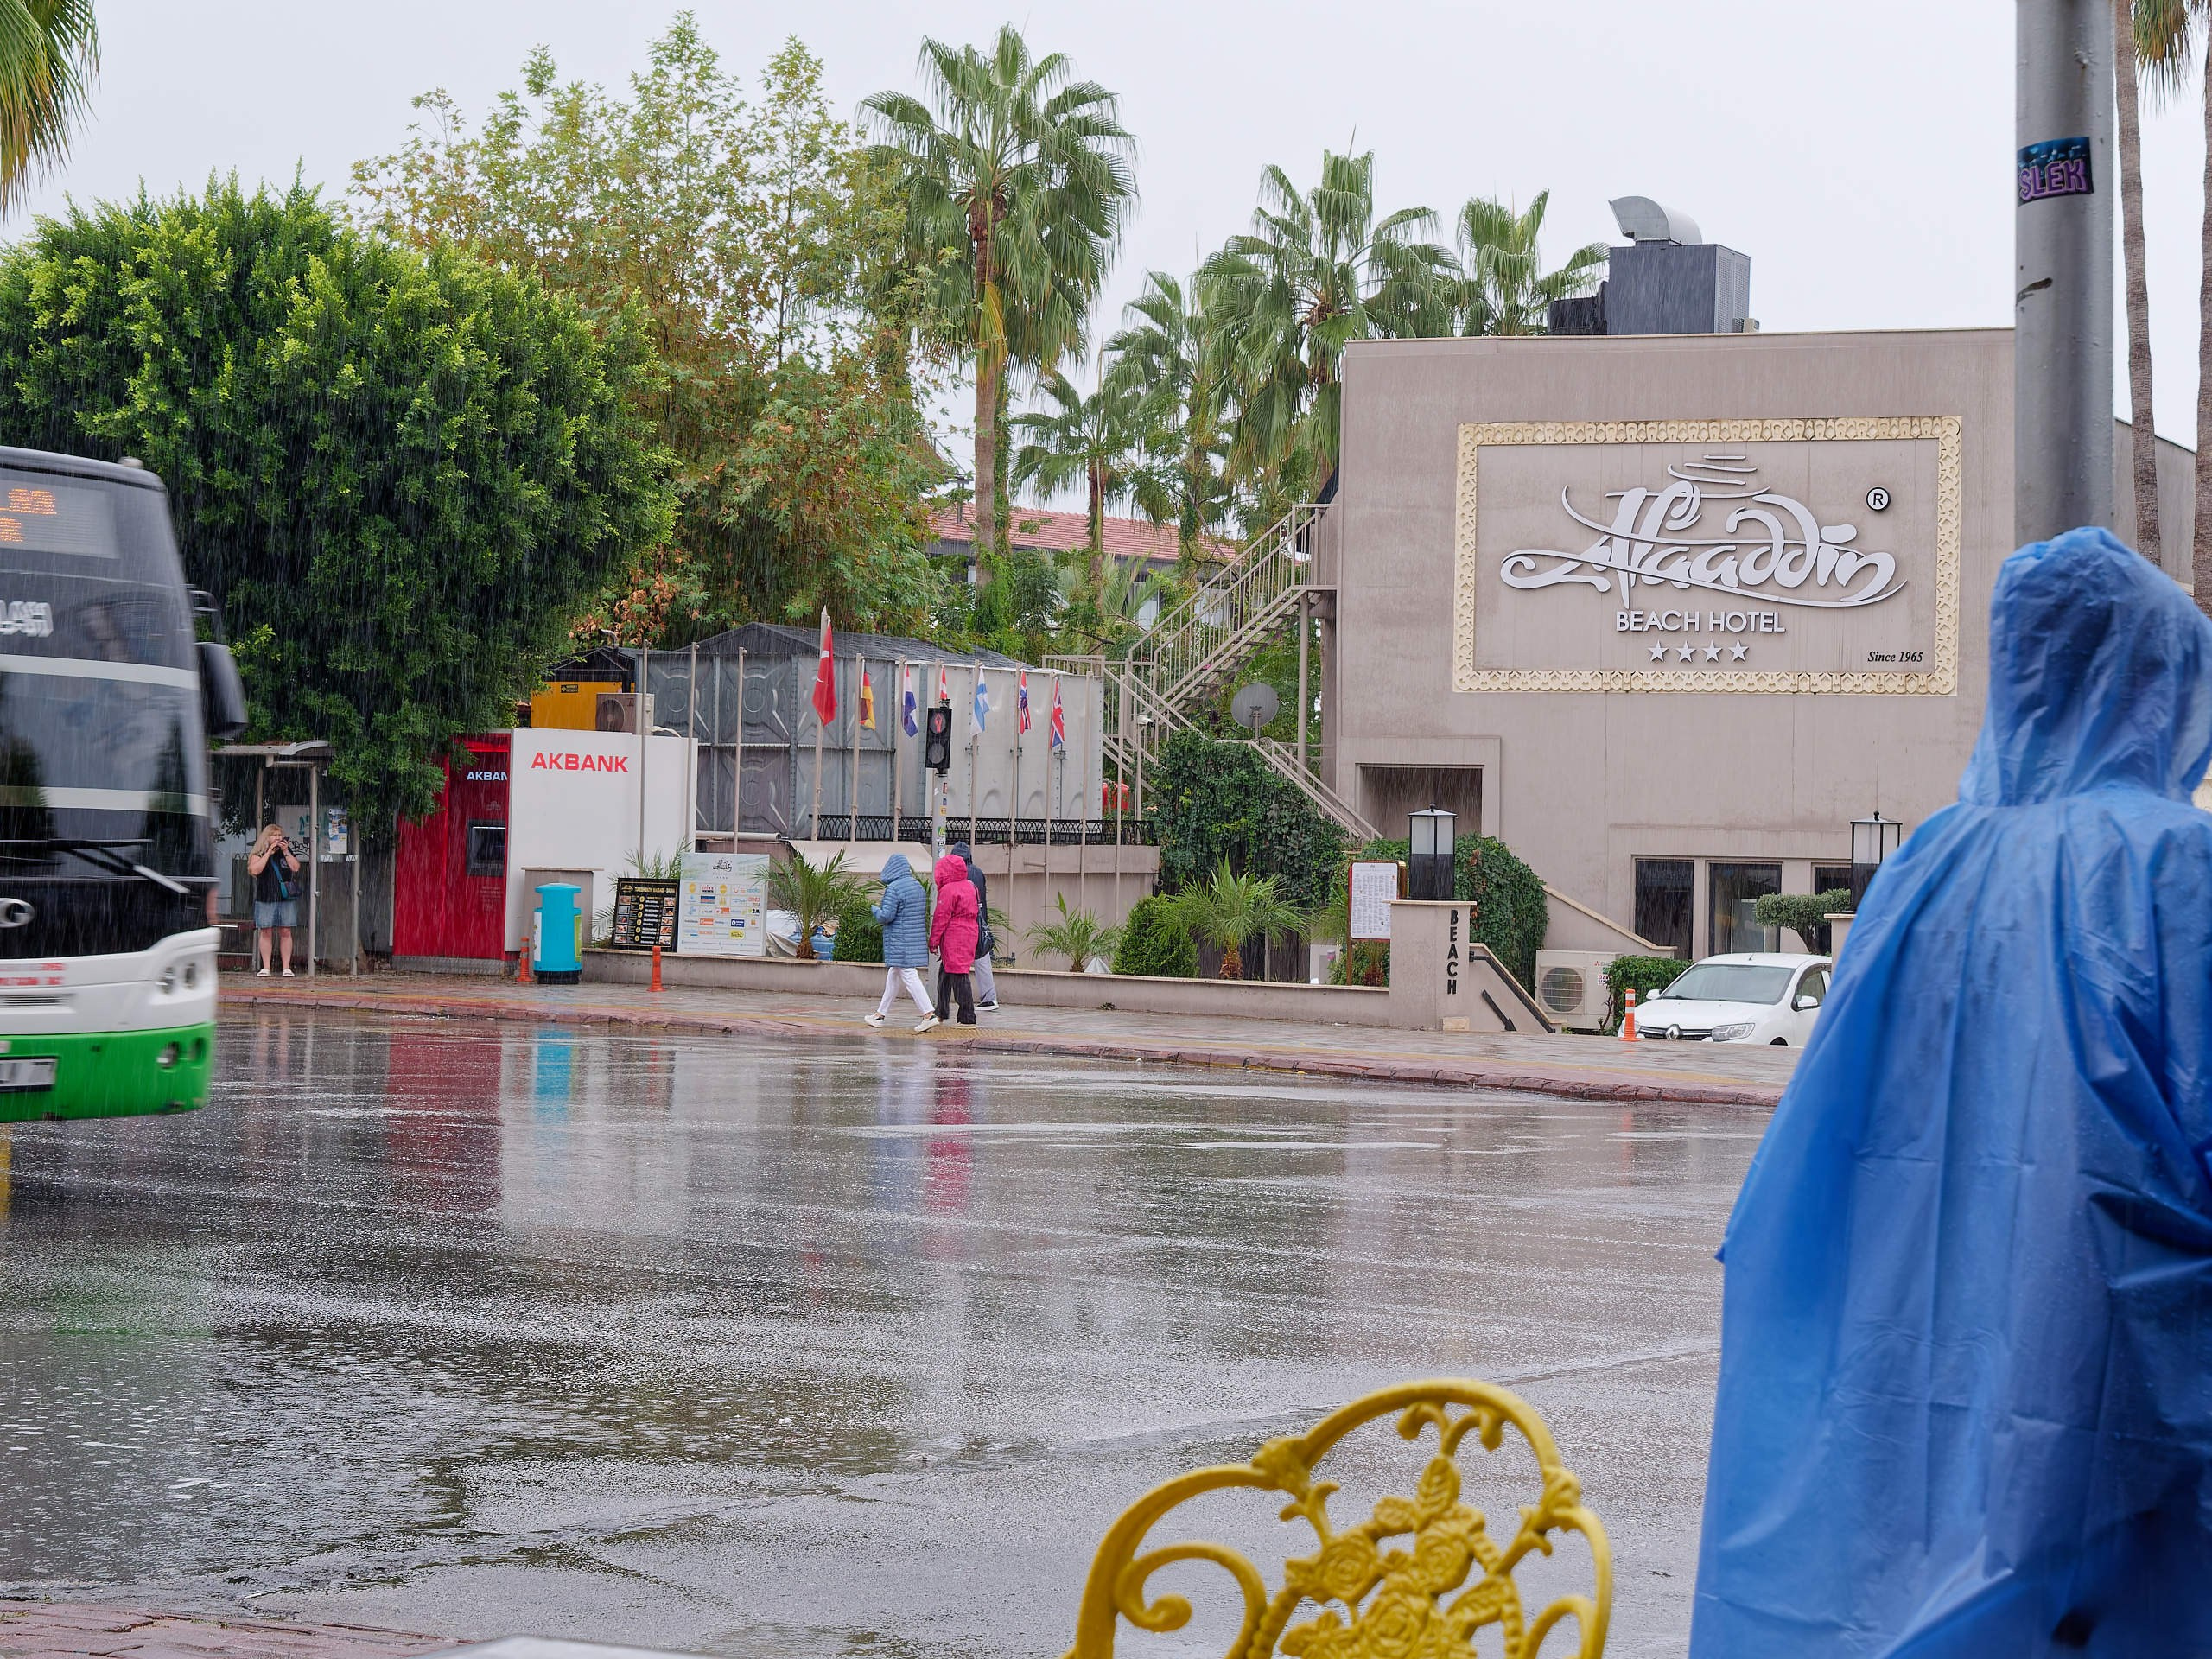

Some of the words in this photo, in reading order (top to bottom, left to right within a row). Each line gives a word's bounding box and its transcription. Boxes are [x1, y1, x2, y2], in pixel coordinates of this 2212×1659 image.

[1617, 610, 1700, 632] BEACH
[1709, 611, 1786, 632] HOTEL
[1867, 651, 1896, 662] Since
[1898, 651, 1923, 662] 1965
[531, 752, 629, 772] AKBANK
[1446, 909, 1459, 995] BEACH
